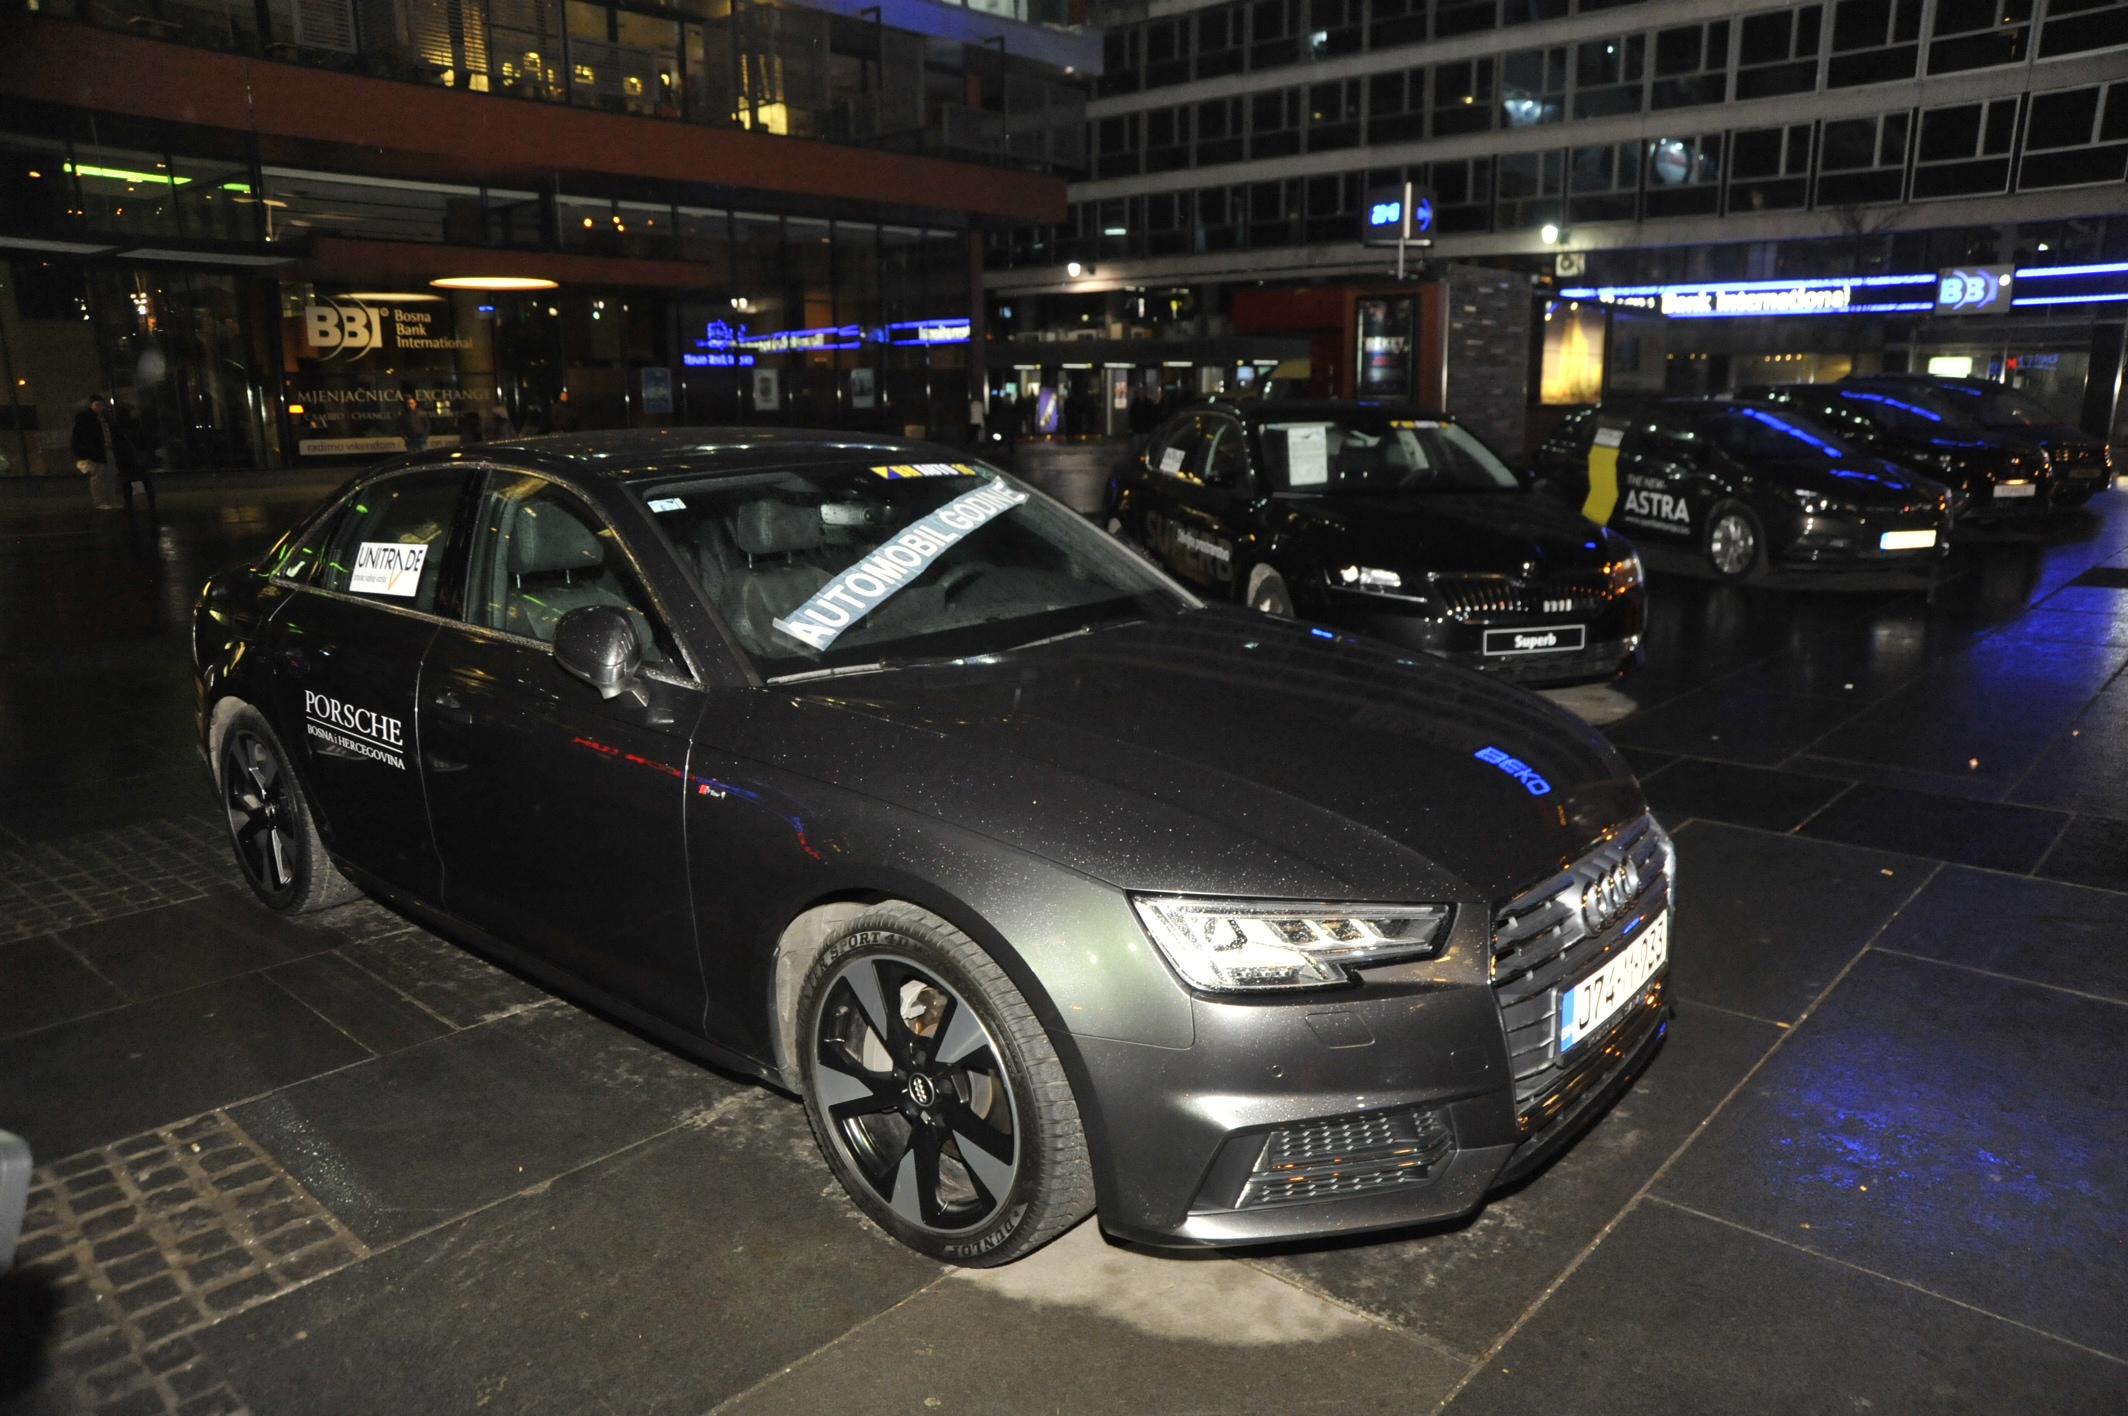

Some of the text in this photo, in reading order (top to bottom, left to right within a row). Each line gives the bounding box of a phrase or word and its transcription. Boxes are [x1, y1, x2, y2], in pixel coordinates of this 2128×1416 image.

[1661, 289, 1712, 314] Bank
[1716, 282, 1851, 313] International
[394, 308, 432, 323] Bosna
[396, 322, 427, 337] Bank
[396, 336, 473, 349] International
[299, 387, 405, 404] MJENJAČNICA
[415, 388, 491, 402] EXCHANGE
[1625, 489, 1690, 523] ASTRA
[358, 546, 424, 572] UNITRADE
[787, 480, 1027, 643] AUTOMOBIL GODINE
[1514, 632, 1557, 649] Superb
[305, 690, 404, 746] PORSCHE
[307, 723, 334, 744] BOSNA
[338, 736, 406, 771] HERCEGOVINA
[830, 931, 881, 960] SPORT
